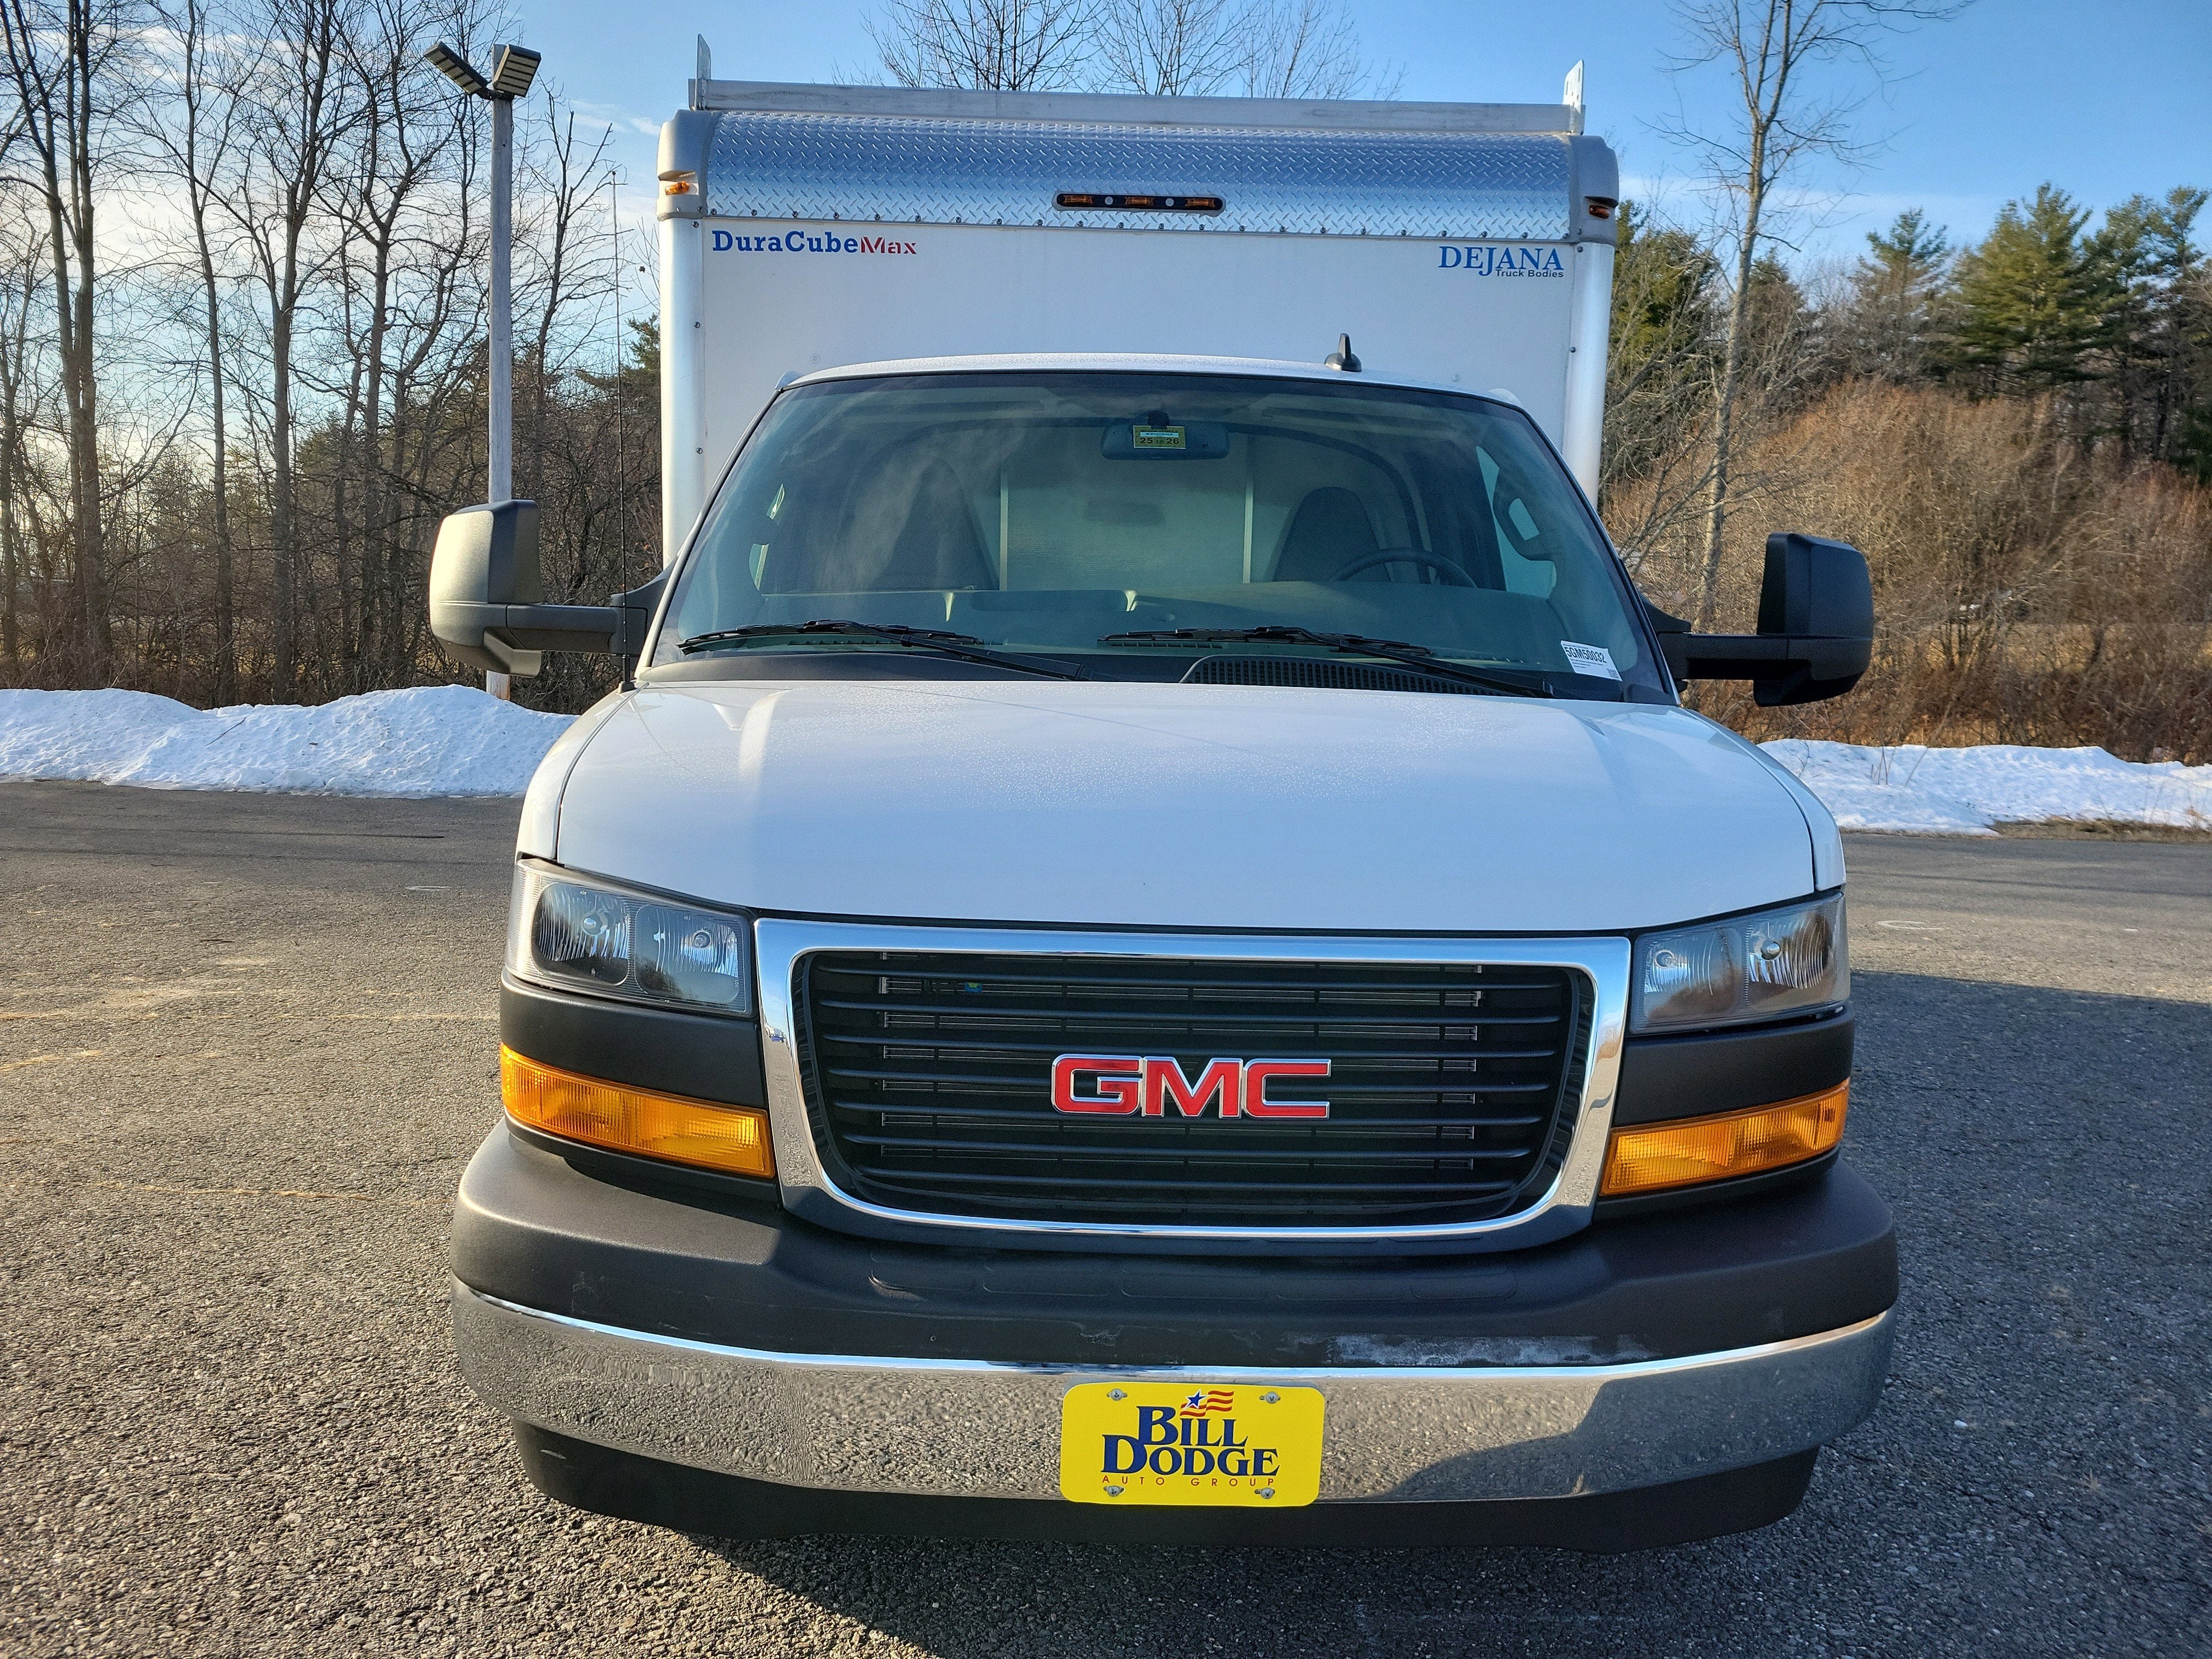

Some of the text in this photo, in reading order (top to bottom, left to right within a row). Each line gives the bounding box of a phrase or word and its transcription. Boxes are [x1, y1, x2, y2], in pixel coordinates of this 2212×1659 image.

[1438, 246, 1564, 276] DEJANA
[1495, 269, 1564, 278] Truck Bodies
[1564, 647, 1607, 663] 5GM50032
[1051, 1053, 1331, 1119] GMC
[1136, 1406, 1248, 1447] BILL
[1101, 1434, 1280, 1476] DODGE
[1102, 1475, 1274, 1487] AUTO GROUP
